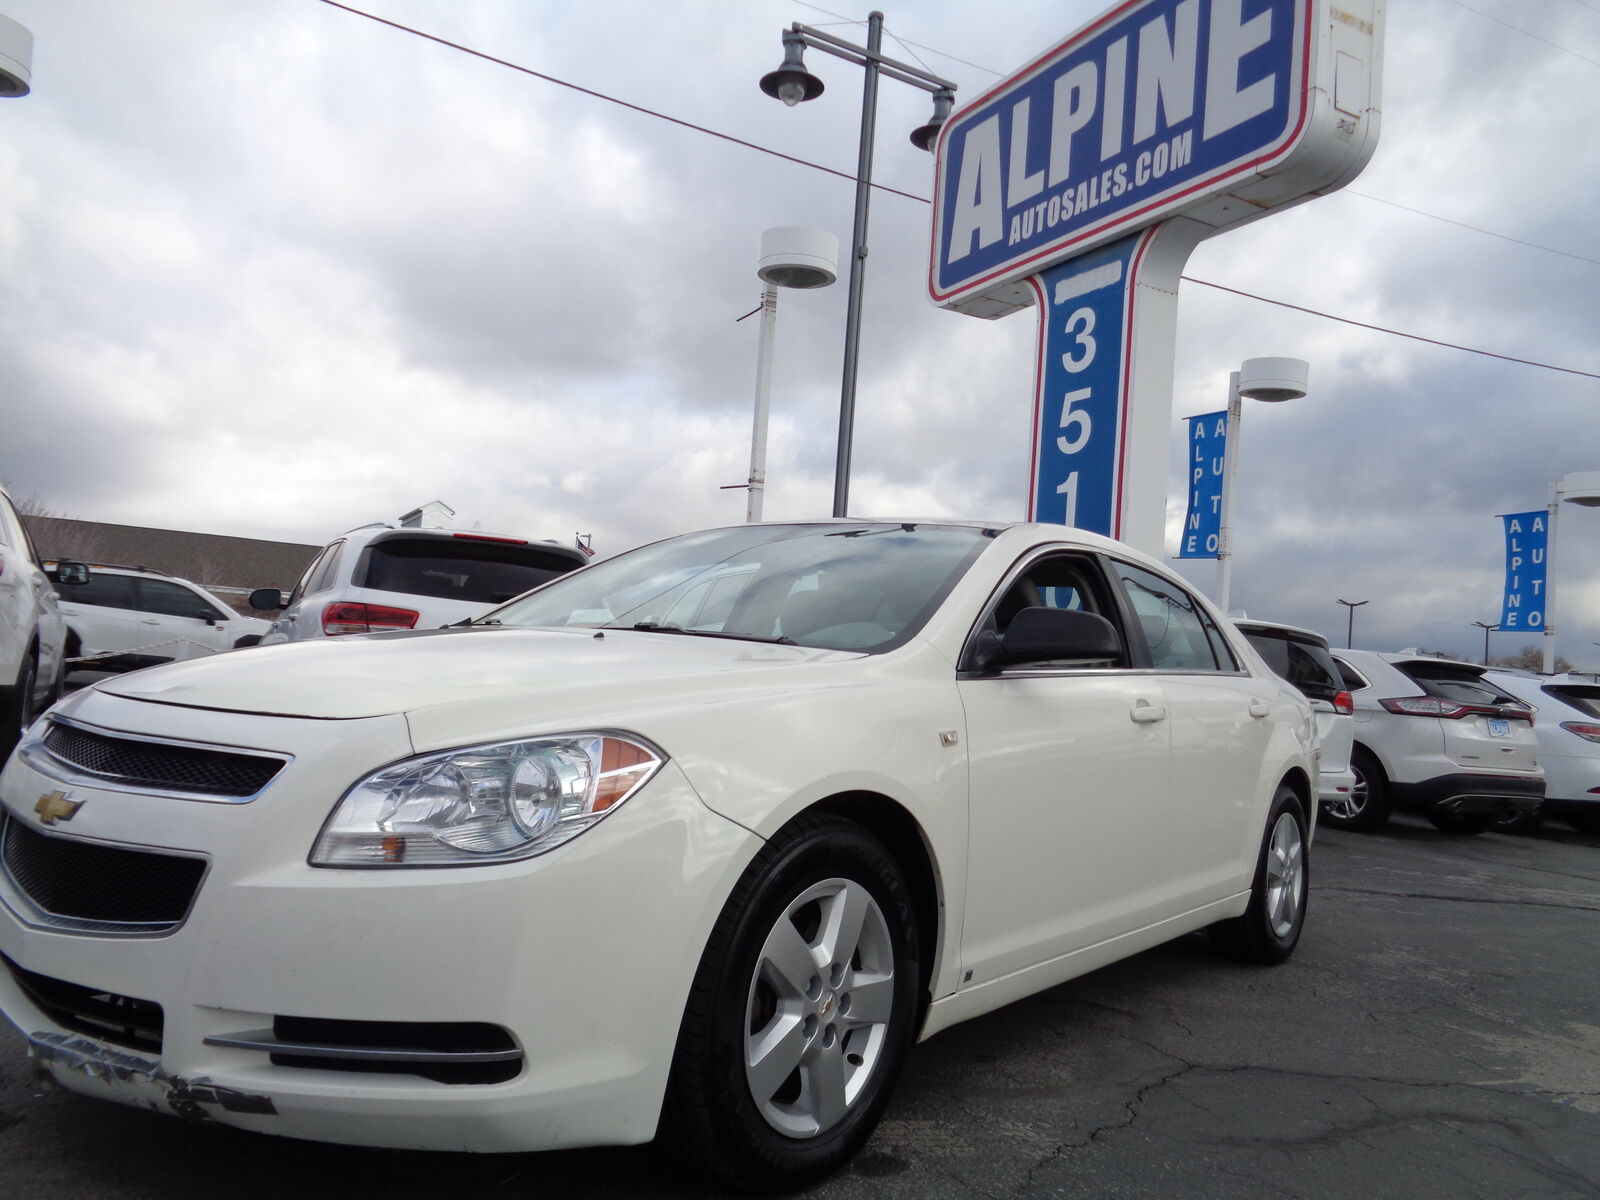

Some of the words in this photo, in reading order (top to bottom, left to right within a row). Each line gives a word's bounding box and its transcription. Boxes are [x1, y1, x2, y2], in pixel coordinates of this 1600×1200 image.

[947, 0, 1276, 265] ALPINE
[1008, 130, 1193, 247] AUTOSALES.COM
[1187, 422, 1206, 553] ALPINE
[1205, 418, 1226, 553] AUTO
[1506, 519, 1522, 626] ALPINE
[1527, 517, 1545, 627] AUTO
